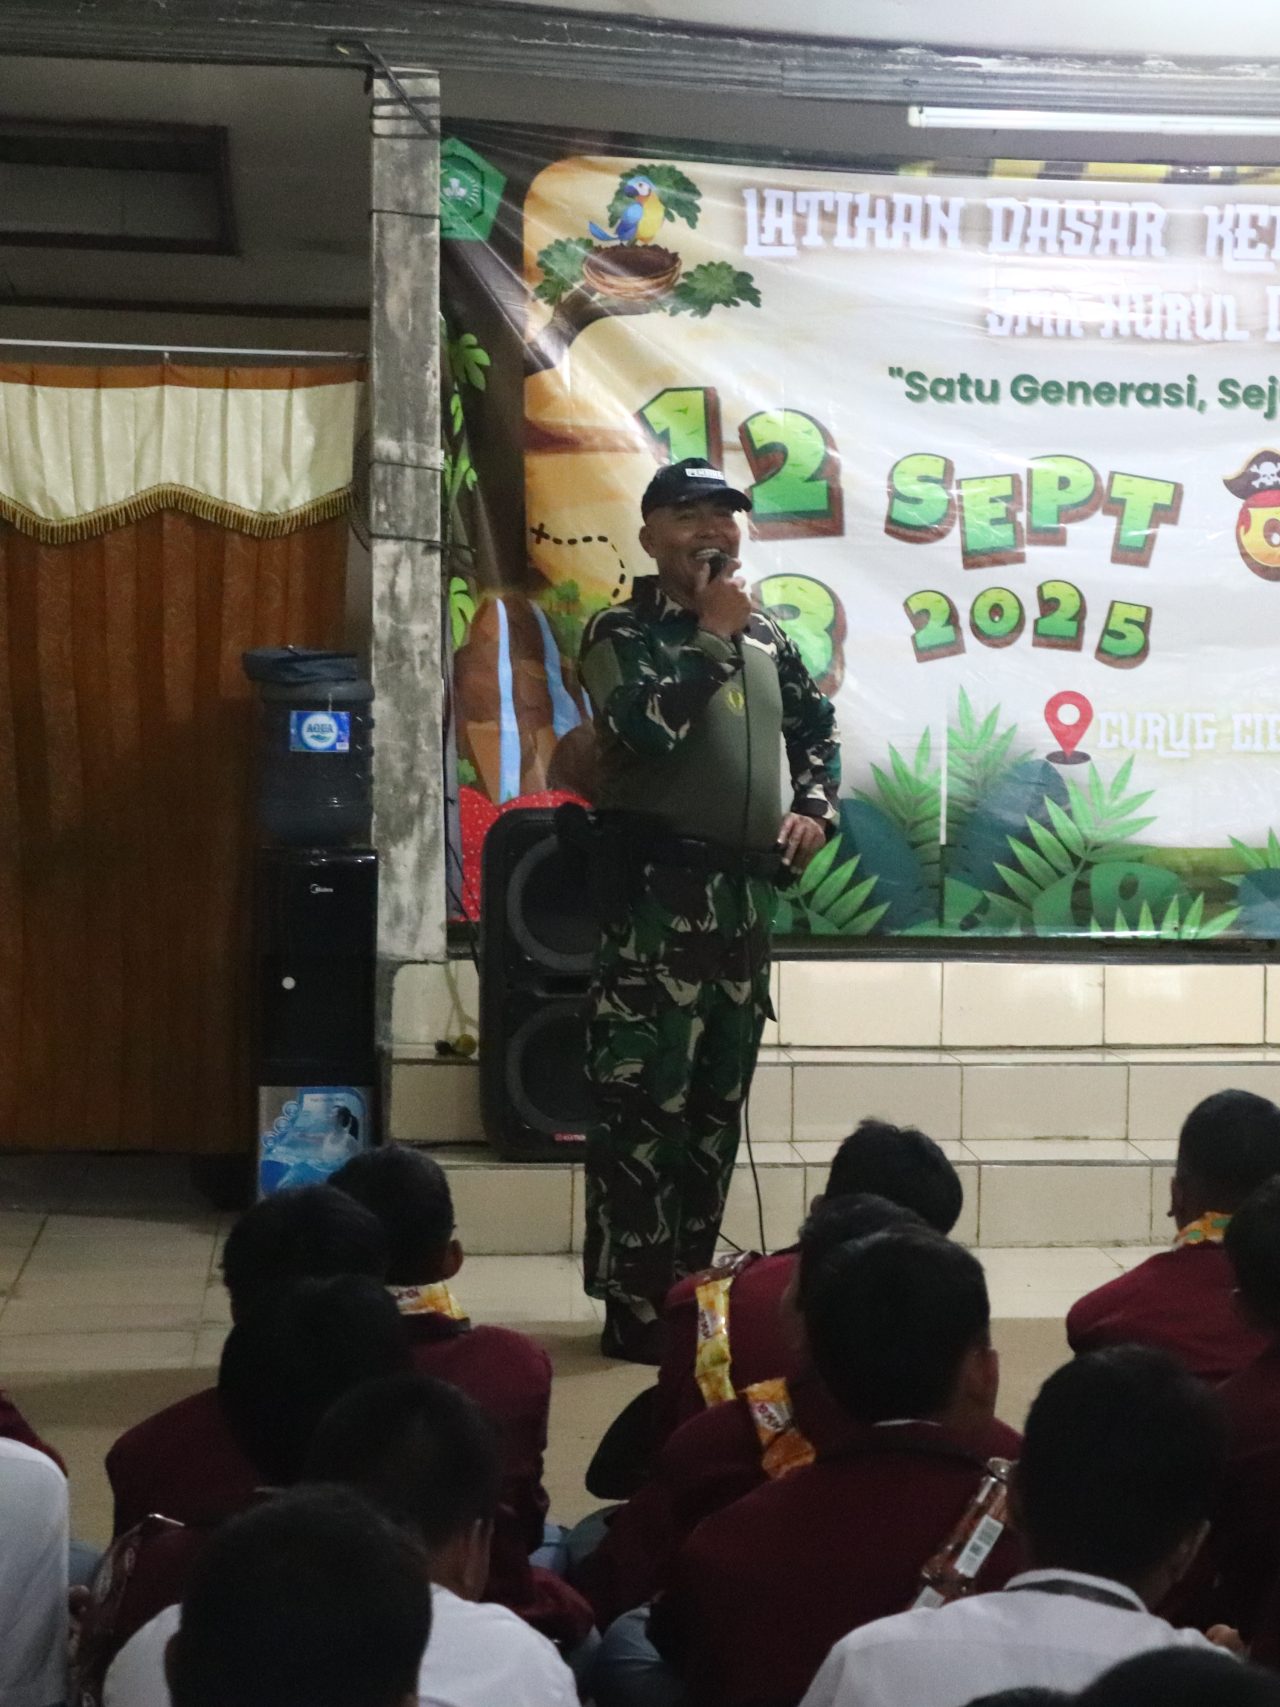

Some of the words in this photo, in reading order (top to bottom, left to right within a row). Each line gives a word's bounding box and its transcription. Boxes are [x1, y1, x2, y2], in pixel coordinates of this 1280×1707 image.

[742, 188, 965, 256] LATIHAN
[987, 197, 1168, 256] DASAR
[1100, 287, 1249, 341] NURUL
[888, 367, 1000, 403] "Satu
[1010, 374, 1206, 414] Generasi,
[884, 453, 1184, 570] SEPT
[903, 579, 1152, 669] 2025
[1098, 712, 1218, 757] CURUG
